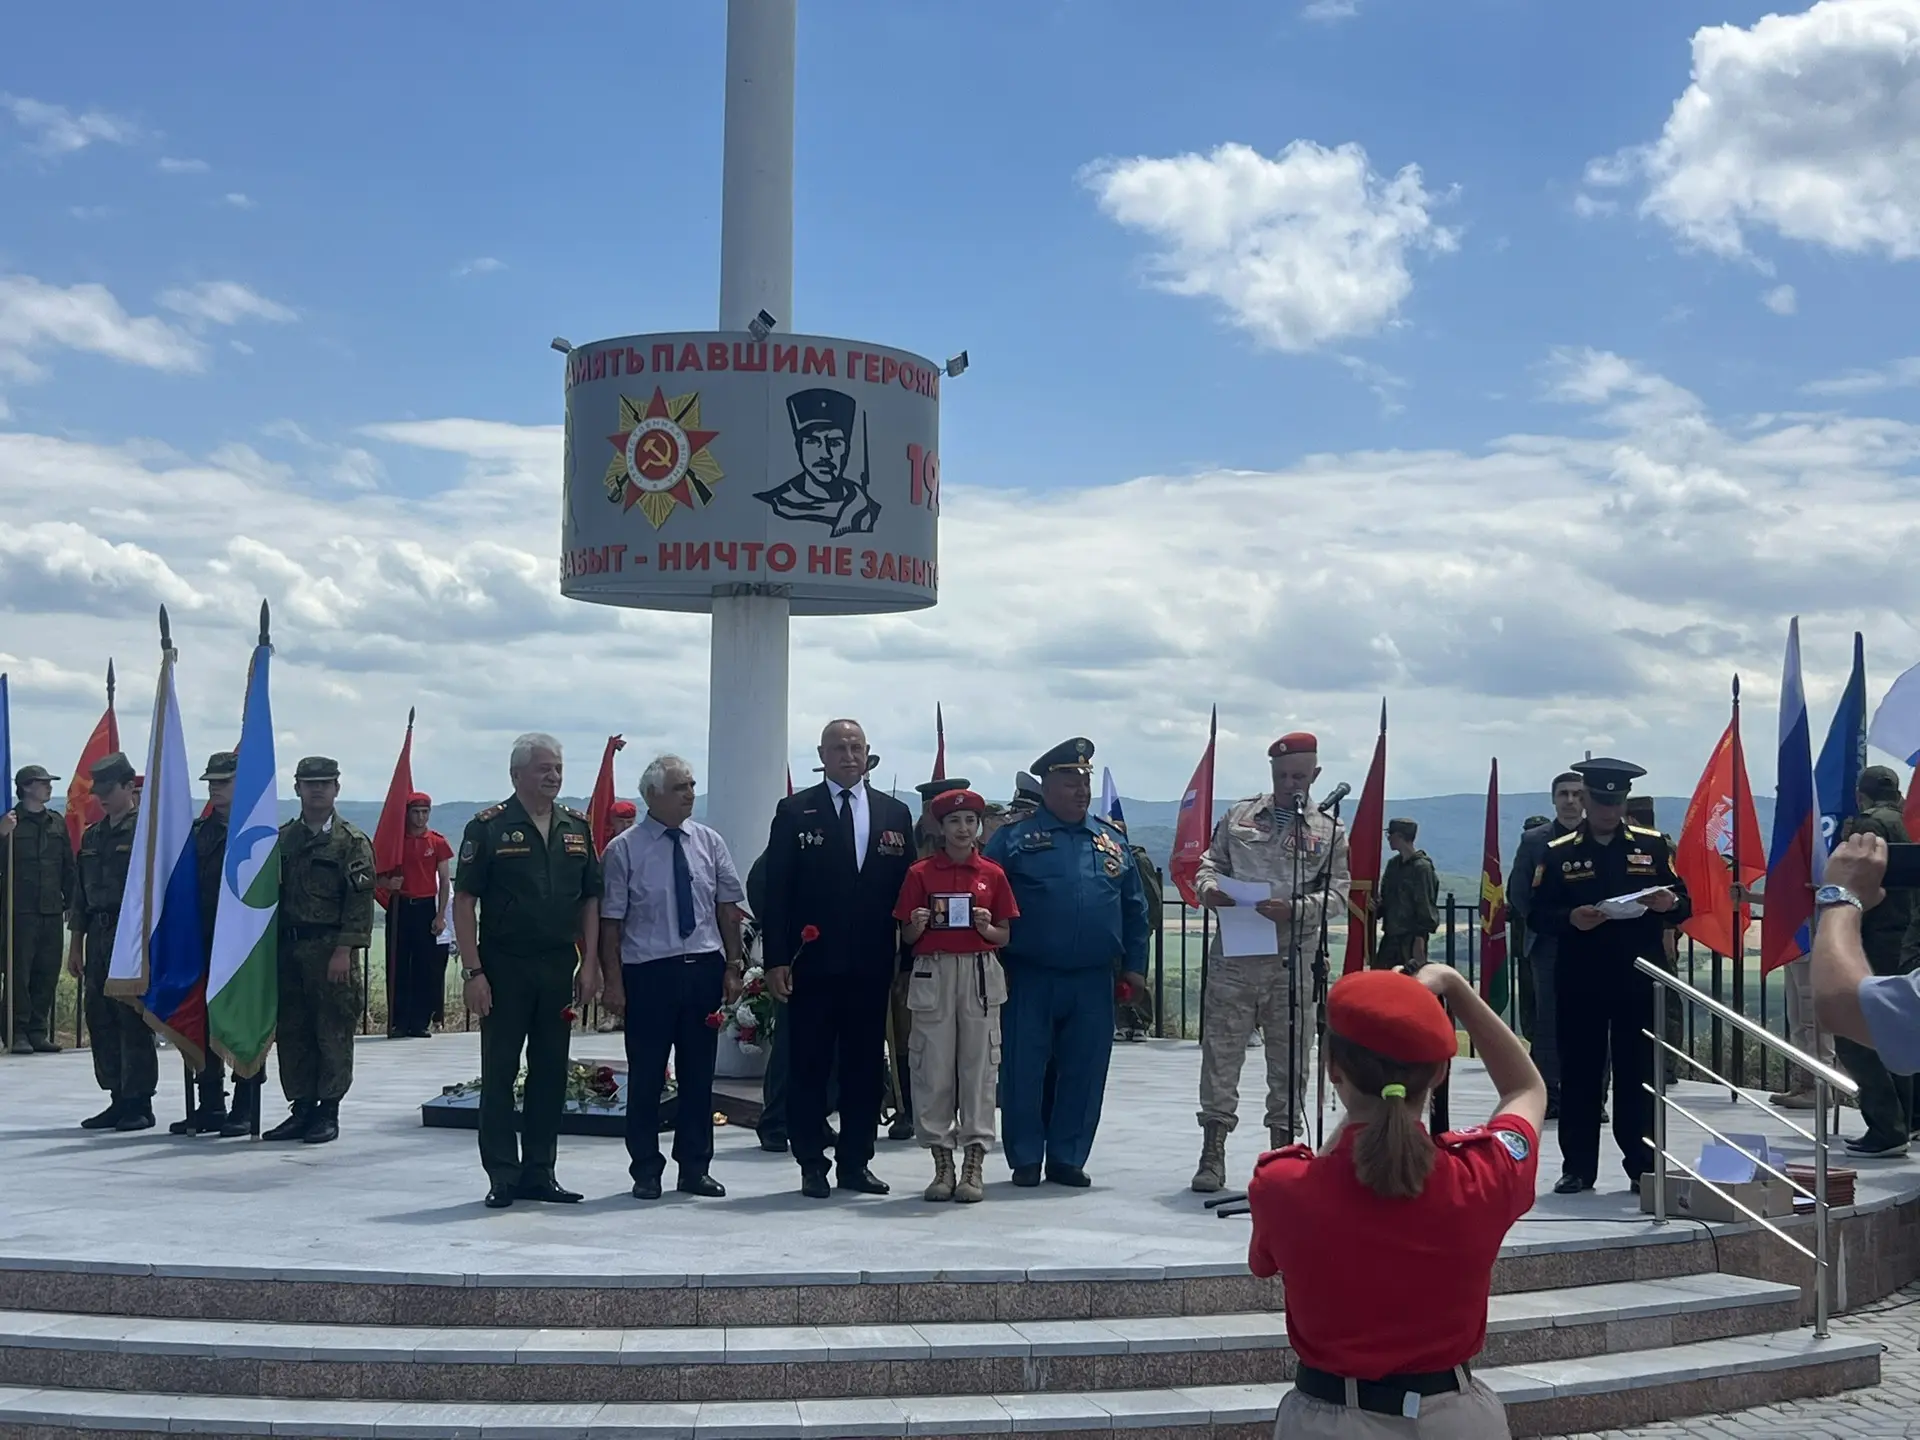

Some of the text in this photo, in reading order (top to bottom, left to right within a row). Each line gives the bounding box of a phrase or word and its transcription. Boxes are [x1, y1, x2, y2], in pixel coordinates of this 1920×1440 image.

[652, 342, 836, 377] ПАВШИМ
[846, 351, 938, 401] ГЕРОЯМ
[634, 555, 648, 565] -
[658, 541, 797, 572] НИЧТО
[808, 545, 853, 577] НЕ
